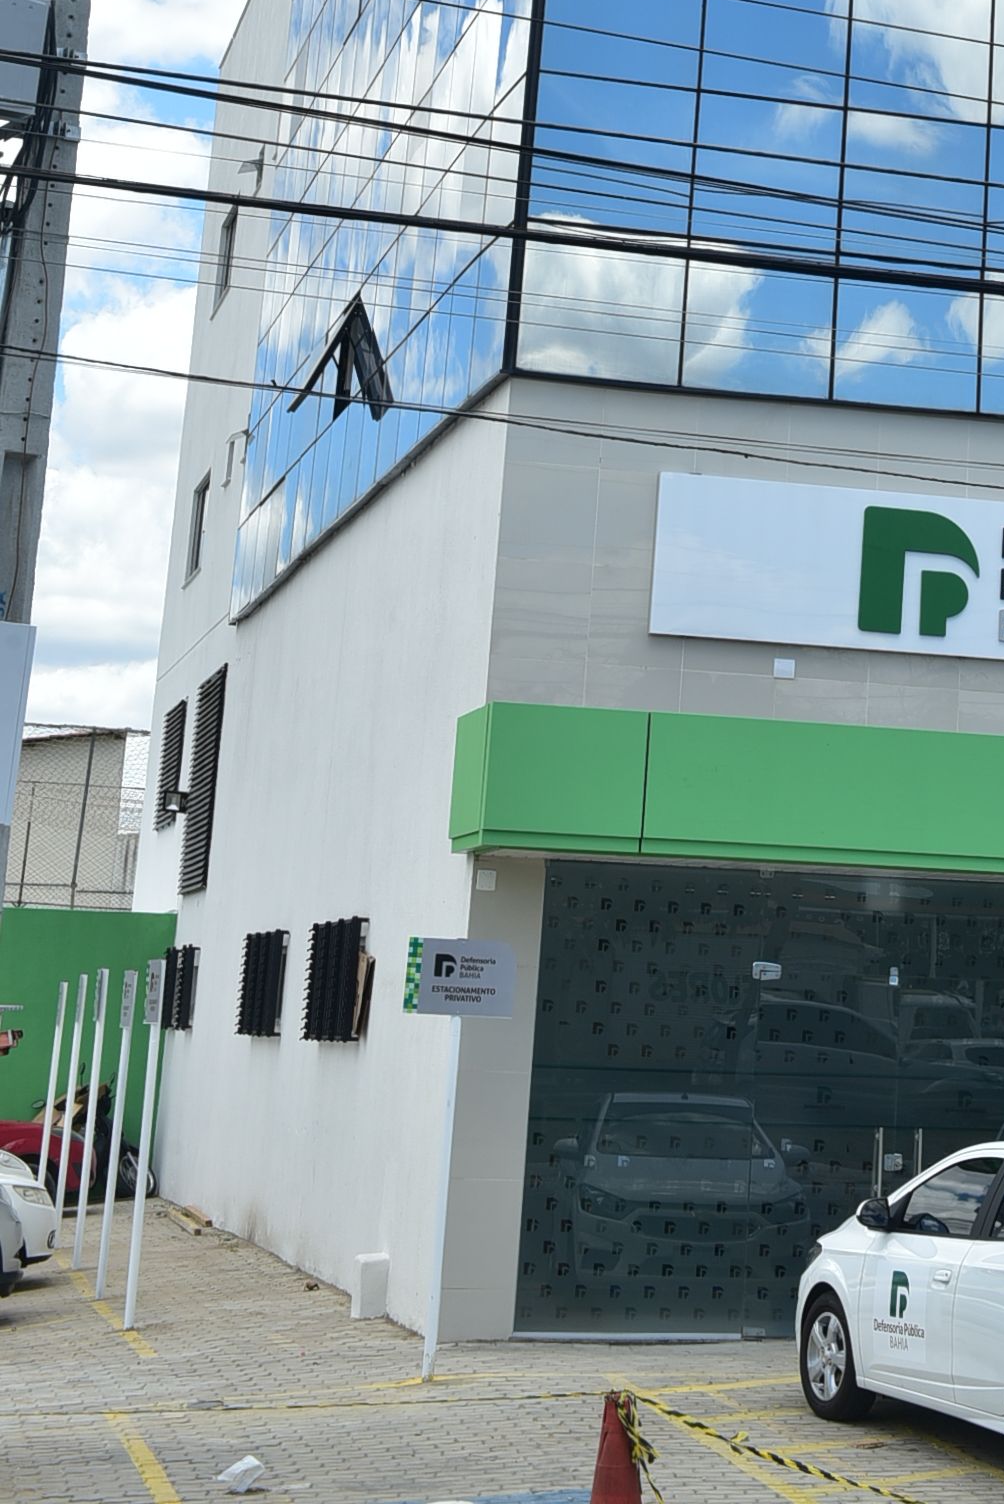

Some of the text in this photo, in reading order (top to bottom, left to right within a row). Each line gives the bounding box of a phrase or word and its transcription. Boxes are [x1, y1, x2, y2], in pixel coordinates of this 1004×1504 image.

[460, 956, 496, 965] Defensoria
[431, 985, 496, 995] ESTACIONAMENTO
[444, 994, 482, 1003] PRIVATIVO
[873, 1318, 925, 1339] Defensoria Pública
[889, 1335, 909, 1351] BAHIA
